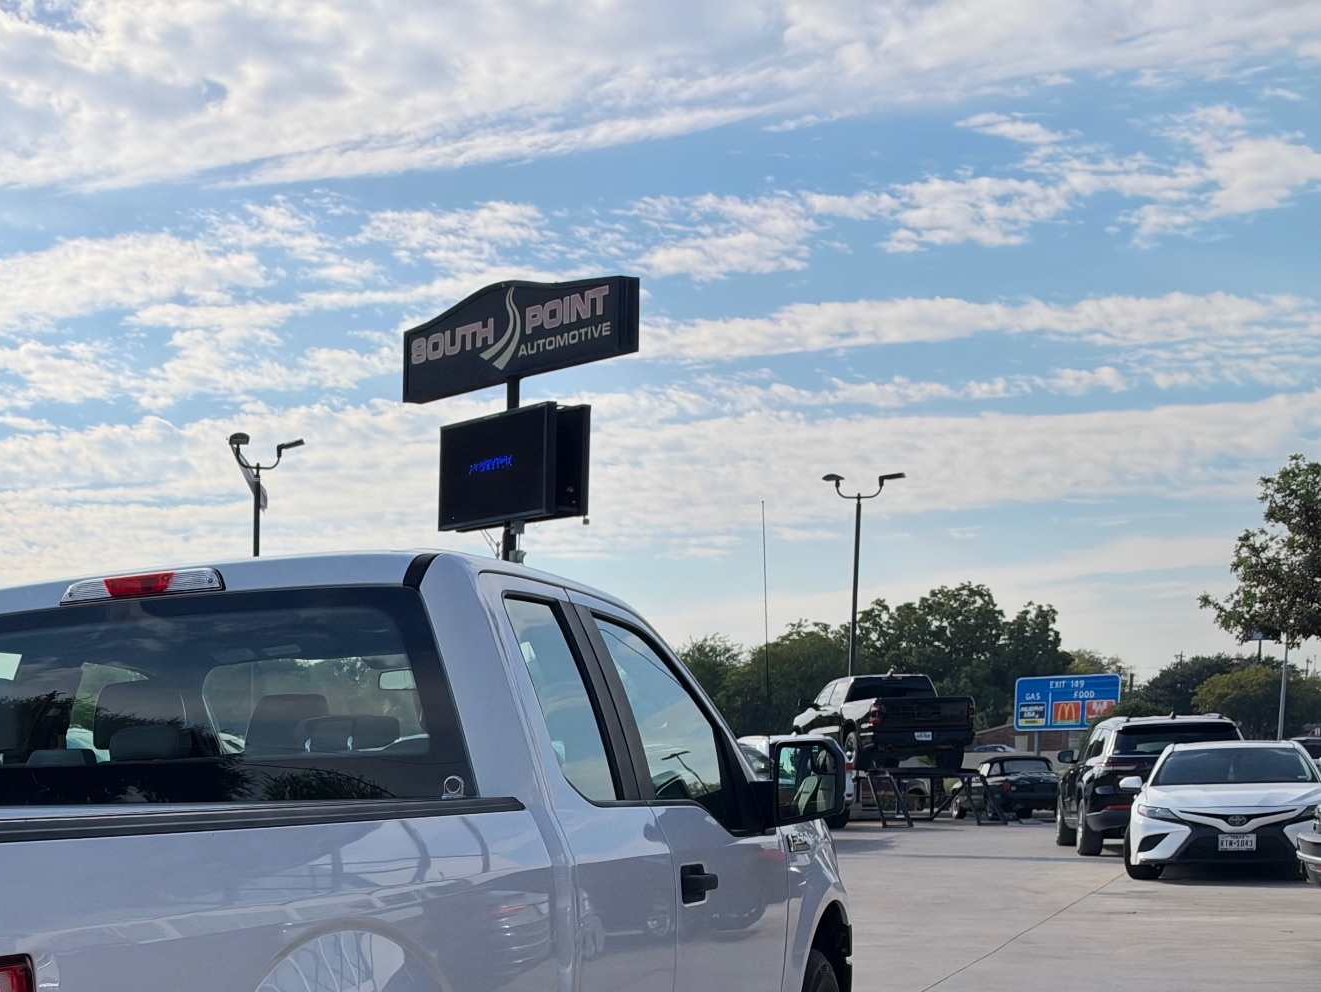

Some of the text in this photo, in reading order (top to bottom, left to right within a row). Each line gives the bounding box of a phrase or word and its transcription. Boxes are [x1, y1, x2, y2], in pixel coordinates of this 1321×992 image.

[411, 285, 609, 364] SOUTH POINT
[517, 321, 611, 358] AUTOMOTIVE
[1049, 680, 1085, 689] EXIT 149
[1025, 692, 1041, 701] GAS
[1073, 690, 1095, 699] FOOD
